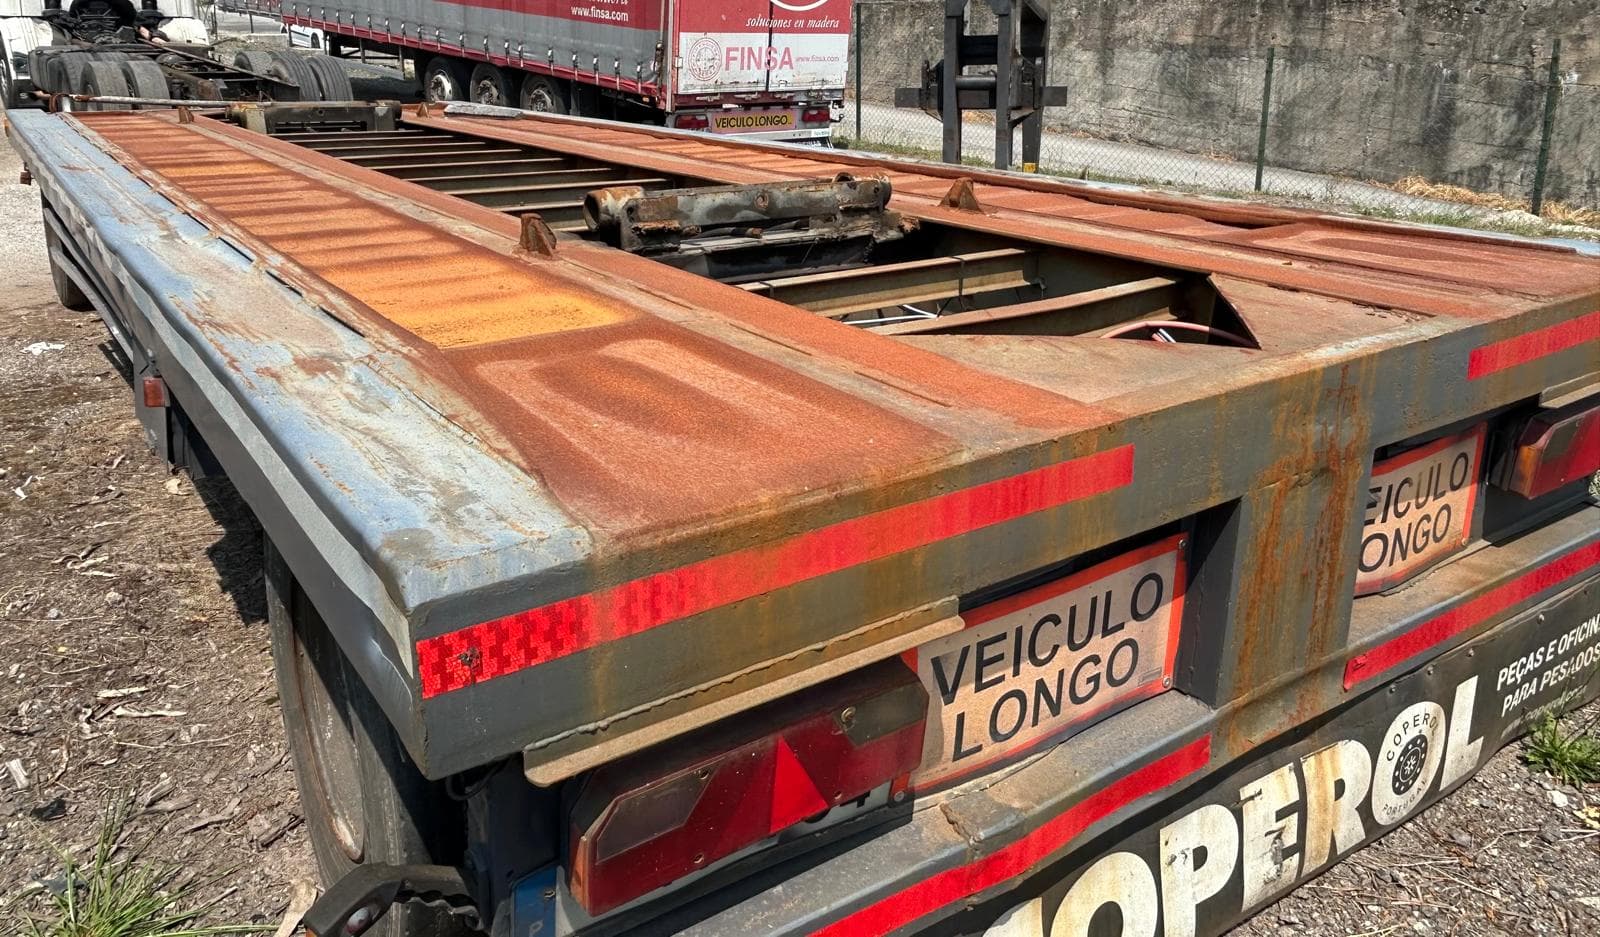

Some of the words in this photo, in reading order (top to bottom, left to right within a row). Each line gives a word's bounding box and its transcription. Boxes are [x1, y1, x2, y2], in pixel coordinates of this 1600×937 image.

[571, 6, 629, 22] www.finsa.com
[746, 13, 791, 28] soluciones
[794, 19, 804, 28] en
[807, 16, 839, 28] madera
[724, 46, 794, 72] FINSA
[715, 116, 754, 129] VEICULO
[755, 115, 788, 126] LONGO
[1363, 451, 1469, 526] EICULO
[1358, 503, 1452, 573] ONGO
[931, 572, 1164, 706] VEICULO
[1497, 646, 1545, 691] PEÇAS
[1546, 639, 1557, 662] E
[1558, 612, 1600, 655] OFICIN
[952, 637, 1139, 762] LONGO
[1501, 677, 1538, 718] PARA
[1386, 712, 1439, 762] COPEROL
[1383, 779, 1426, 816] PORTUGAL
